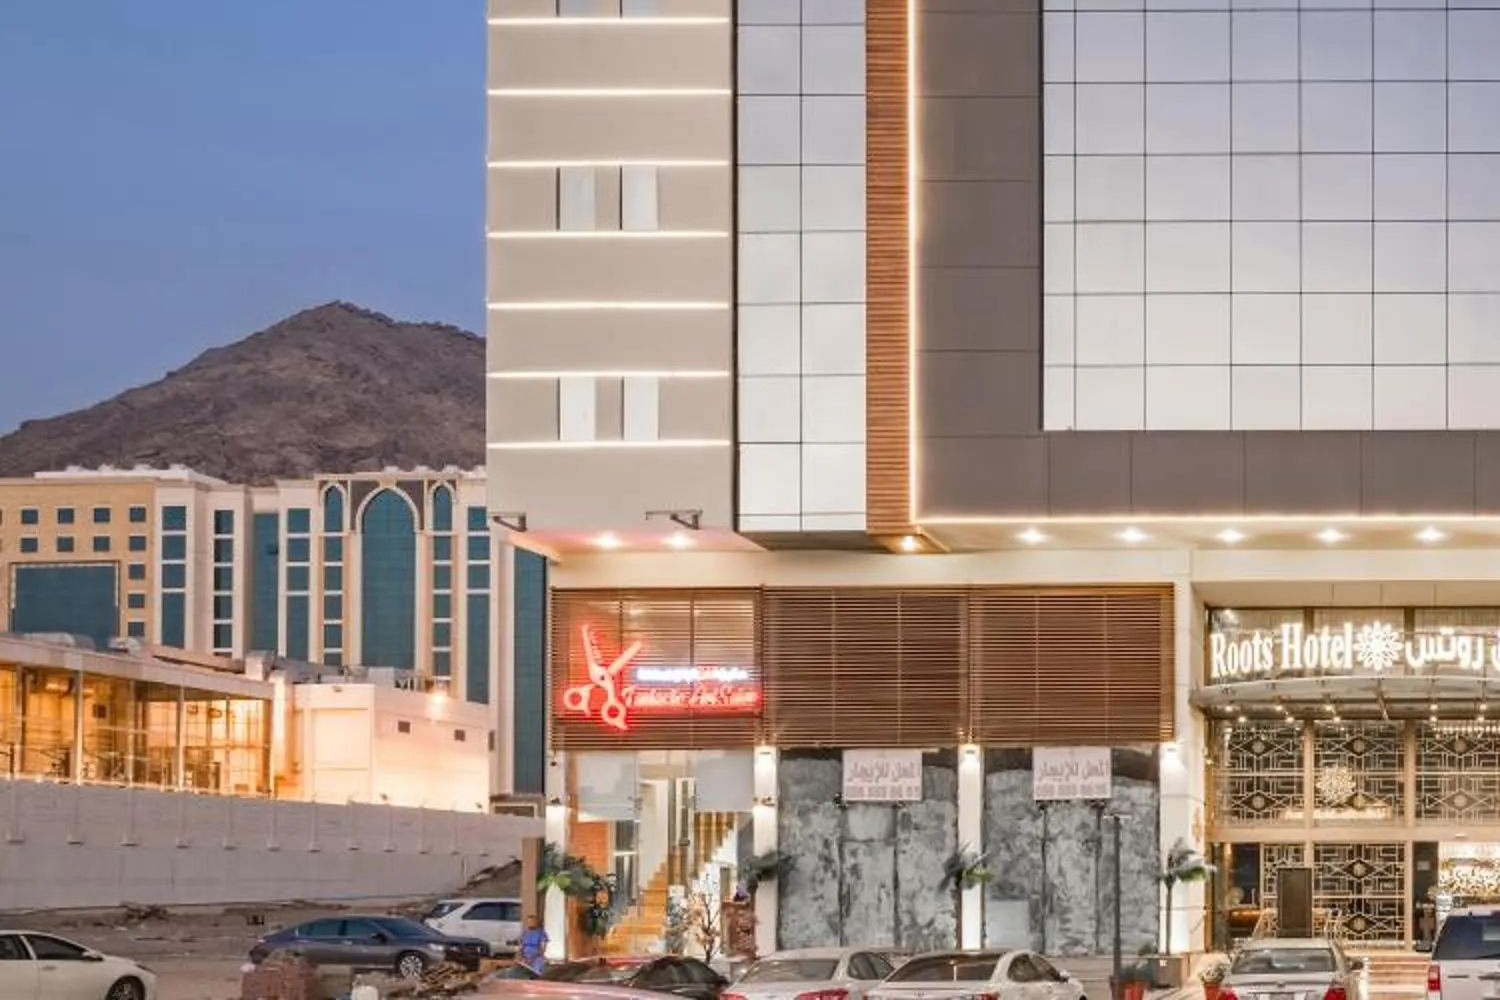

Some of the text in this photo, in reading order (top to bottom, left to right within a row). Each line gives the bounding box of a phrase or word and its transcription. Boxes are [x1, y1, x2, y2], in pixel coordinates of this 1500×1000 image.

[1210, 622, 1353, 678] Roots Hotel
[1405, 627, 1484, 670] روتس
